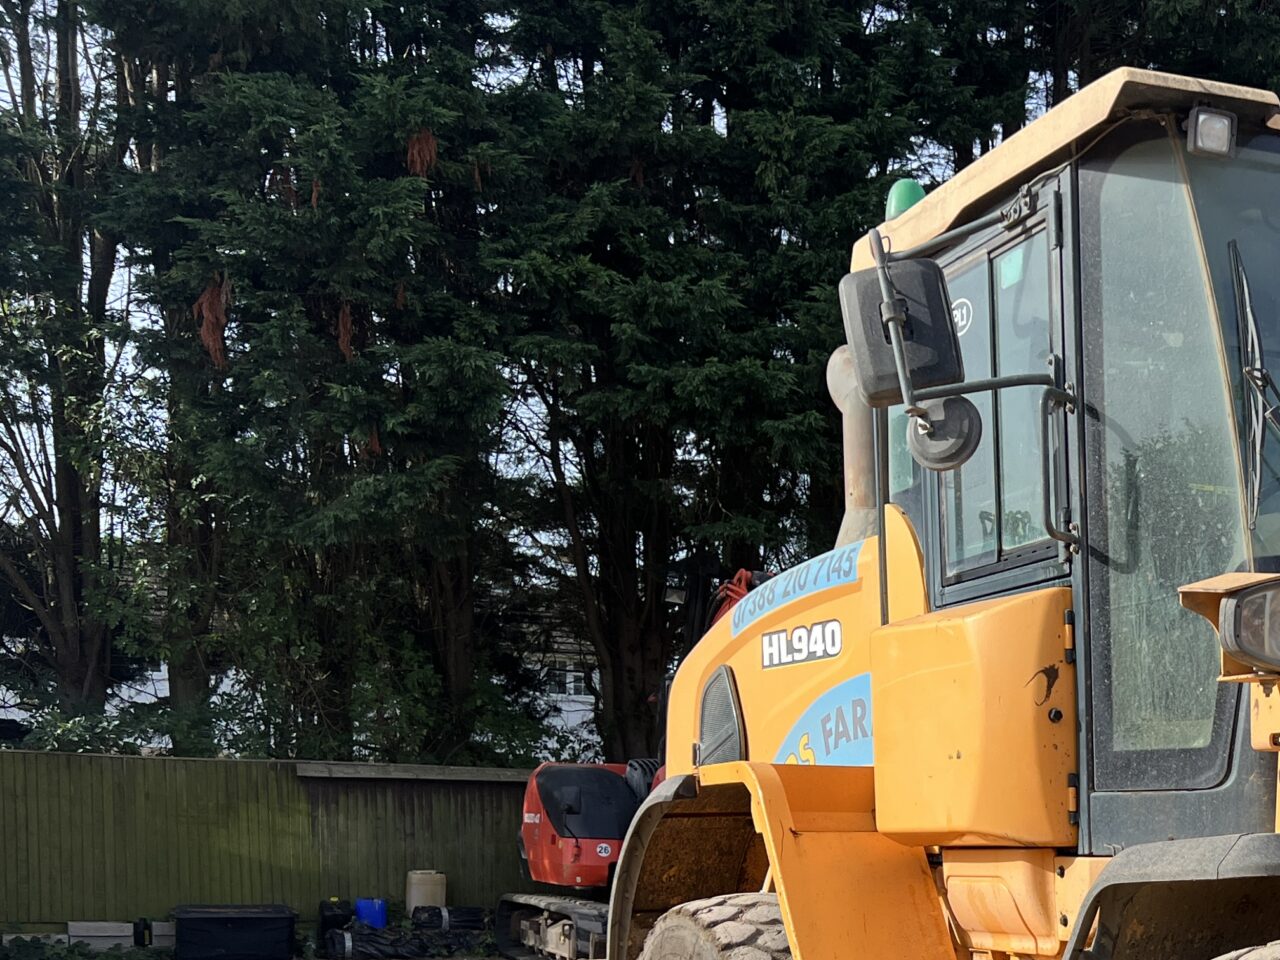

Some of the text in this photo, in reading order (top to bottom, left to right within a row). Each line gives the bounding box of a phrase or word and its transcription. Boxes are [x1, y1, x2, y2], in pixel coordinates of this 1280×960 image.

[782, 562, 811, 599] 210
[762, 619, 842, 668] HL940
[820, 698, 874, 757] FAR
[598, 845, 610, 855] 26
